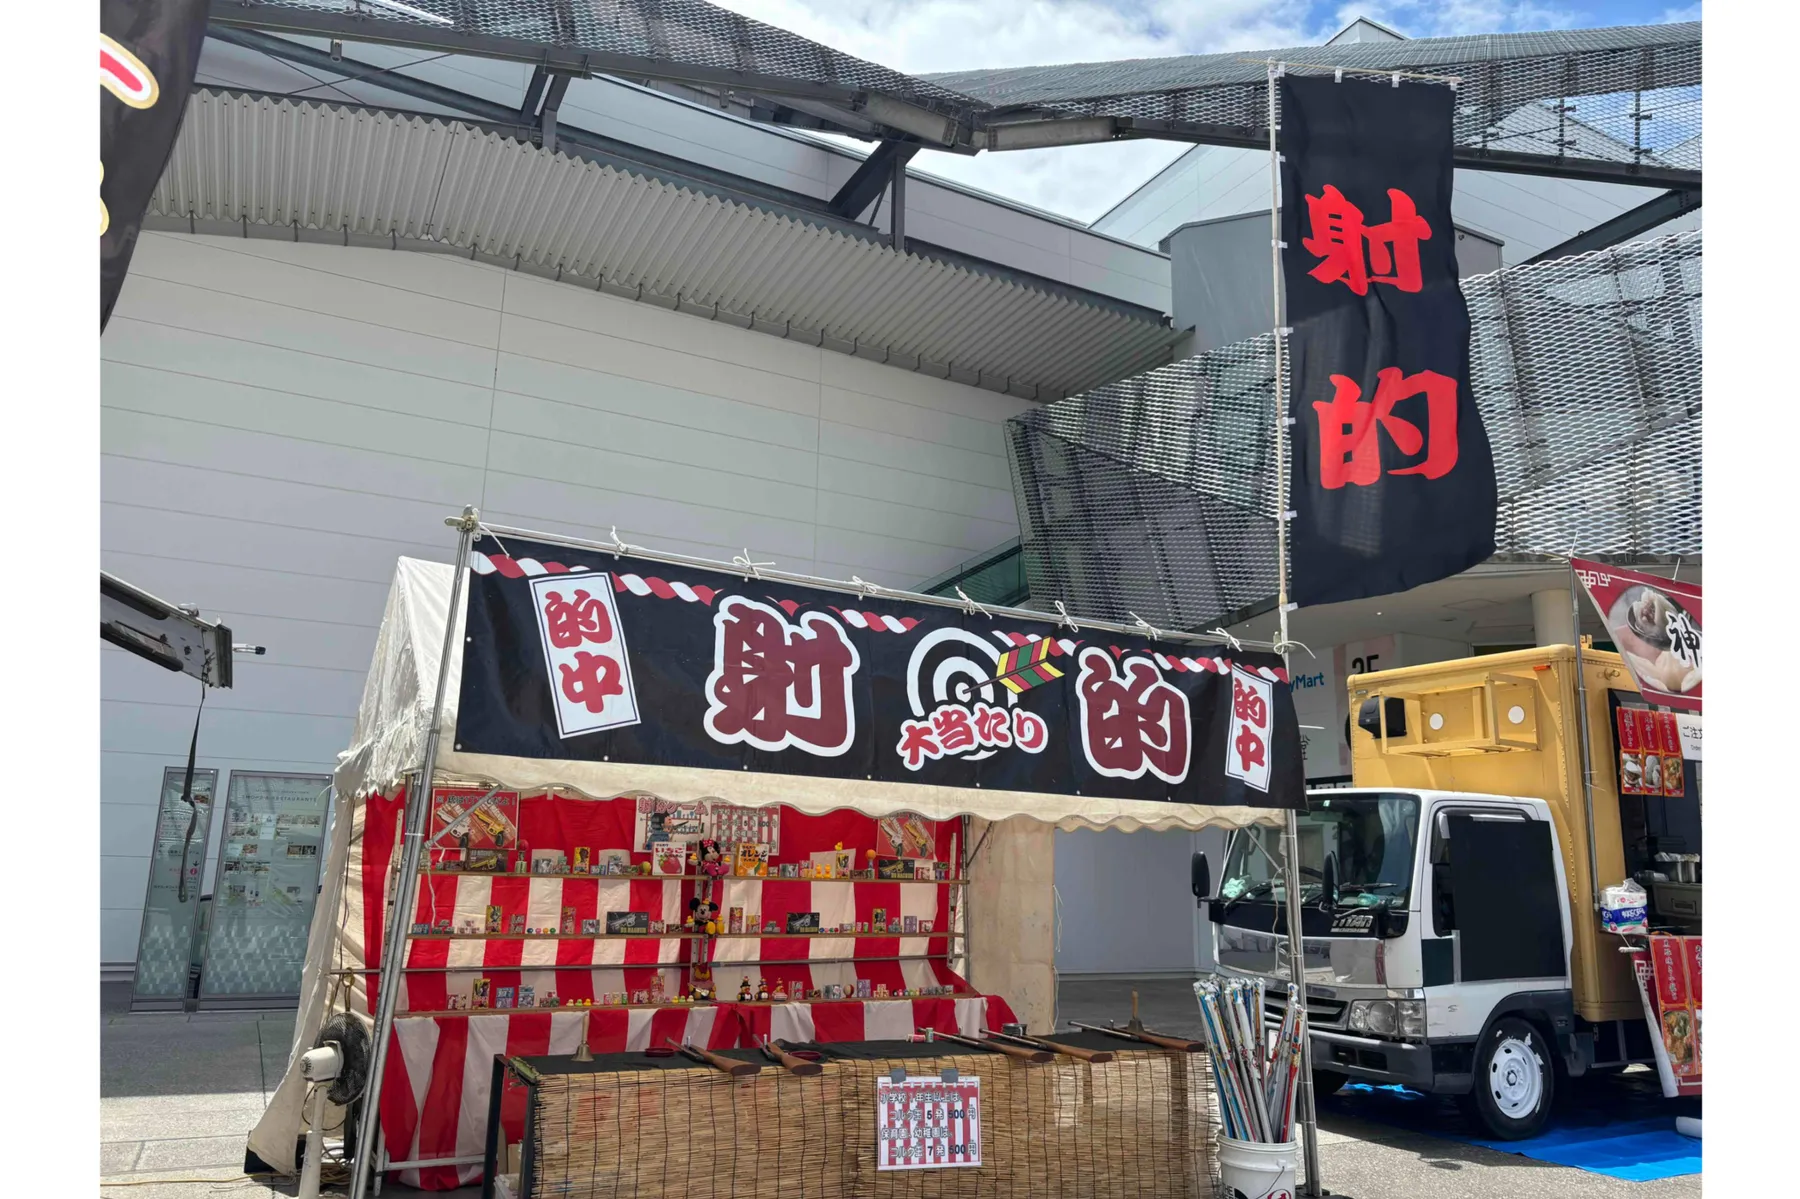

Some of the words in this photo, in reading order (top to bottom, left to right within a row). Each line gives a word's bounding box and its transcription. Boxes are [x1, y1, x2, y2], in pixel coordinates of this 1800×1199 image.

[1302, 184, 1458, 489] 射的
[544, 588, 624, 714] 的中
[705, 597, 859, 755] 射
[1077, 648, 1190, 782] 的
[898, 706, 1046, 769] 大当たり
[1234, 677, 1268, 772] 的中
